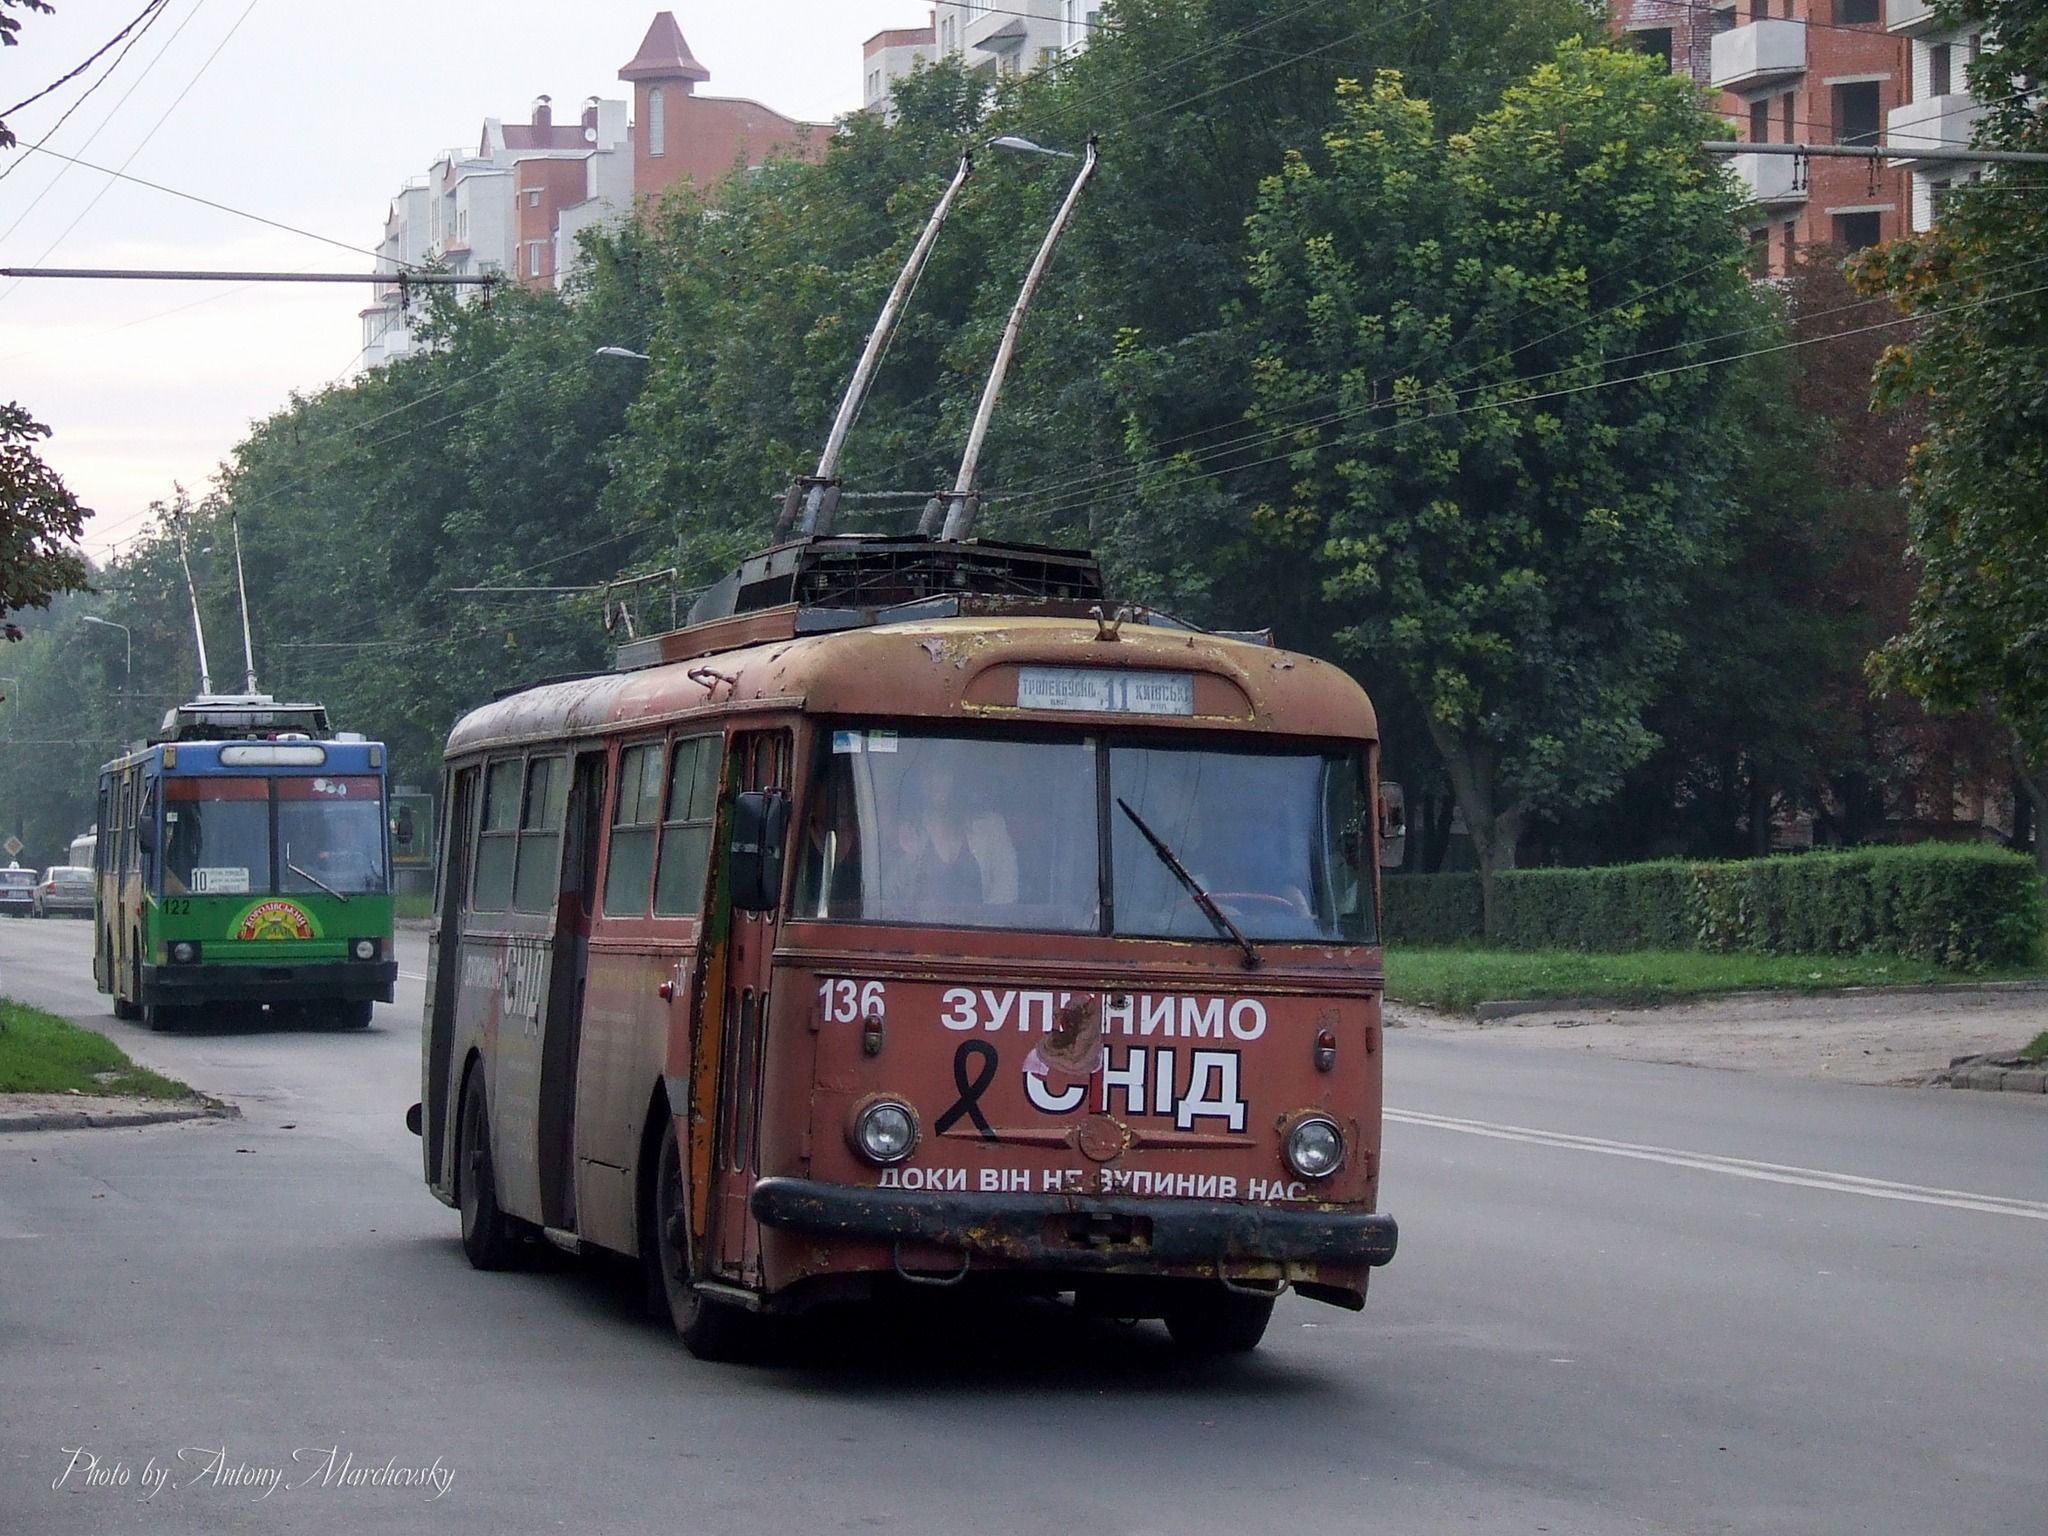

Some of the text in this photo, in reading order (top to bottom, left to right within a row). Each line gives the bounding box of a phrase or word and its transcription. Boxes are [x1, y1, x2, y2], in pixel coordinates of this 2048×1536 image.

[194, 871, 207, 892] 10
[163, 900, 190, 915] 122
[819, 979, 886, 1023] 136
[940, 989, 1267, 1040] ЗУПНИМО
[879, 1167, 967, 1192] ДОКИ
[980, 1168, 1031, 1193] ВІН
[1100, 1168, 1237, 1199] ЗУПИНИВ
[1248, 1177, 1306, 1201] НАС
